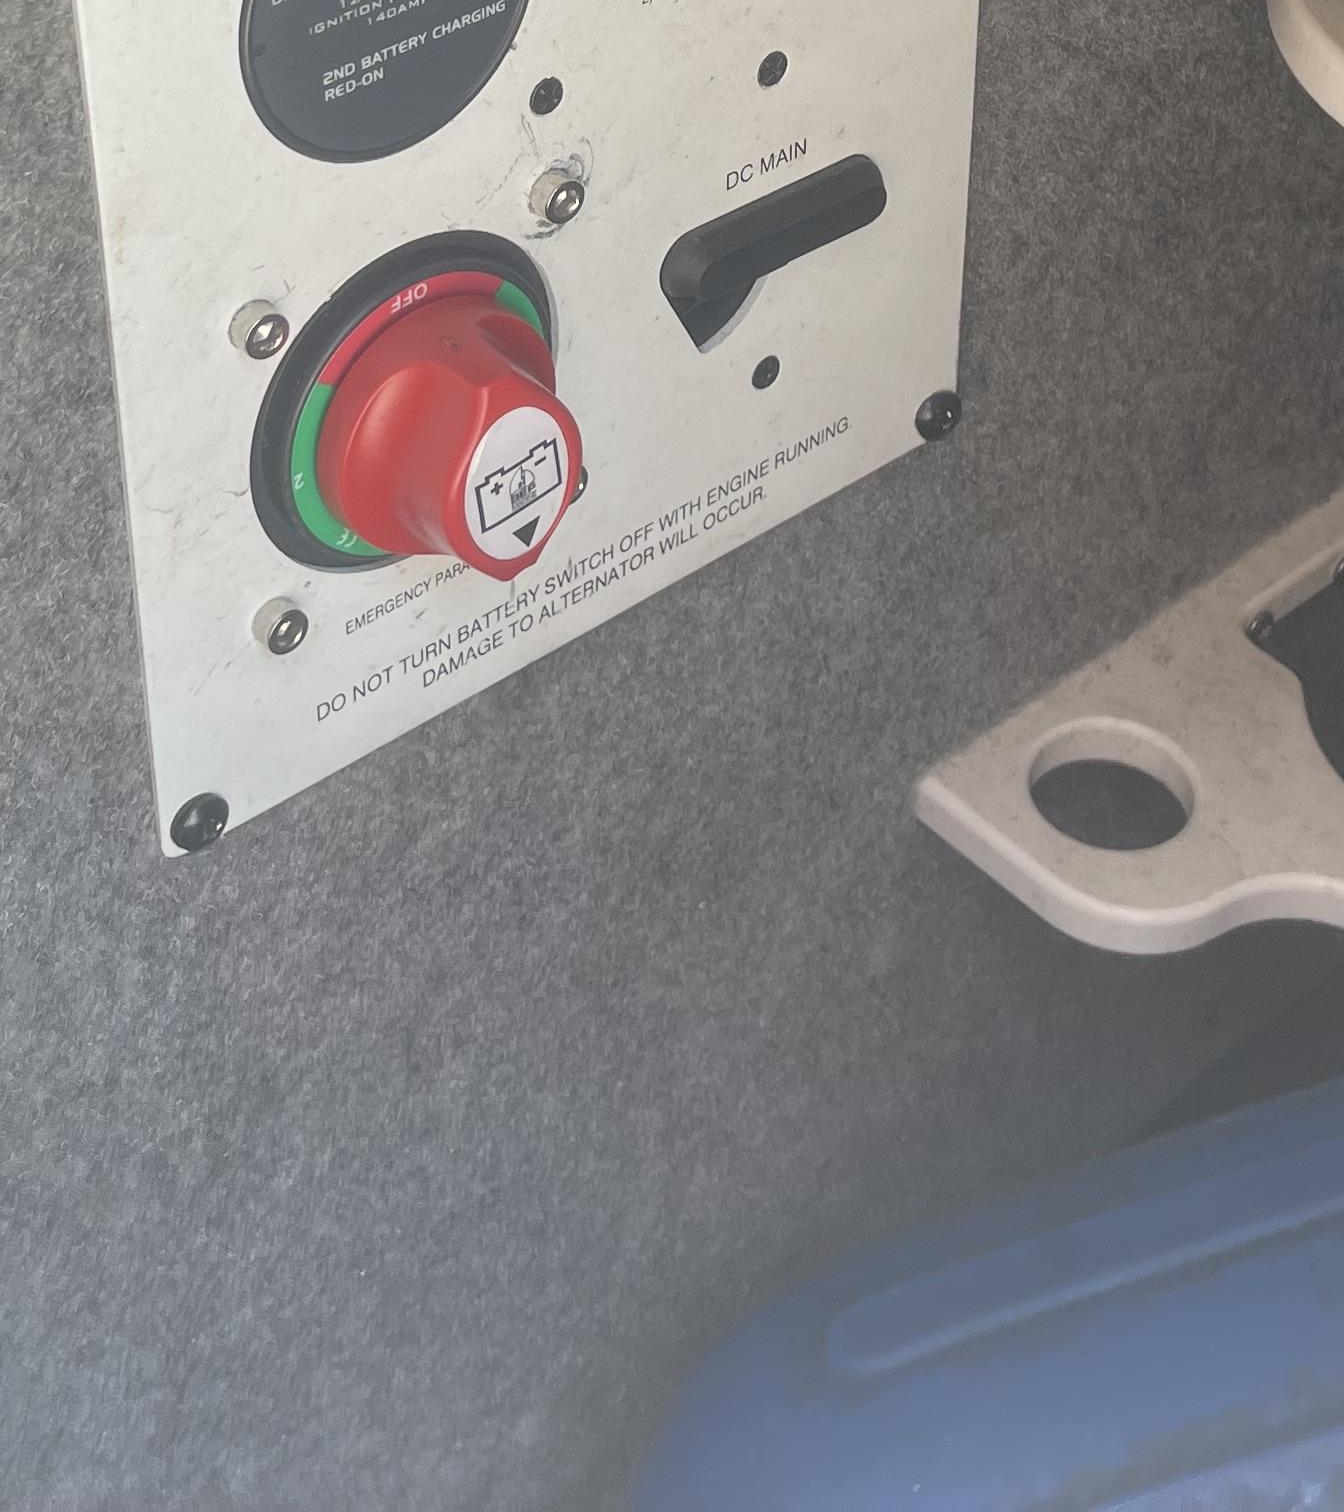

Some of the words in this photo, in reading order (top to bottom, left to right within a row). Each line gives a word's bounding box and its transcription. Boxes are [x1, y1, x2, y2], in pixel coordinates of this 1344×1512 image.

[309, 0, 382, 35] IGNITION
[322, 62, 356, 86] 2ND
[361, 31, 428, 70] BATTERY
[432, 0, 506, 39] CHARGING
[324, 67, 384, 102] RED-ON
[726, 163, 754, 191] DC
[760, 138, 807, 175] MAIN
[390, 283, 428, 314] OFF
[316, 693, 346, 722] DO
[353, 665, 393, 702] NOT
[399, 634, 451, 674] TURN
[458, 584, 539, 644] BATTERY
[544, 544, 615, 596] SWITCH
[619, 521, 655, 554] OFF
[658, 497, 702, 532] WITH
[707, 459, 770, 507] ENGINE
[774, 416, 853, 469] RUNNING.
[422, 629, 504, 688] DAMAGE
[508, 614, 534, 639] TO
[539, 547, 655, 625] ALTERNATOR
[660, 528, 699, 556] WILL
[703, 486, 767, 530] OCCUR.
[345, 578, 431, 635] EMERGENCY
